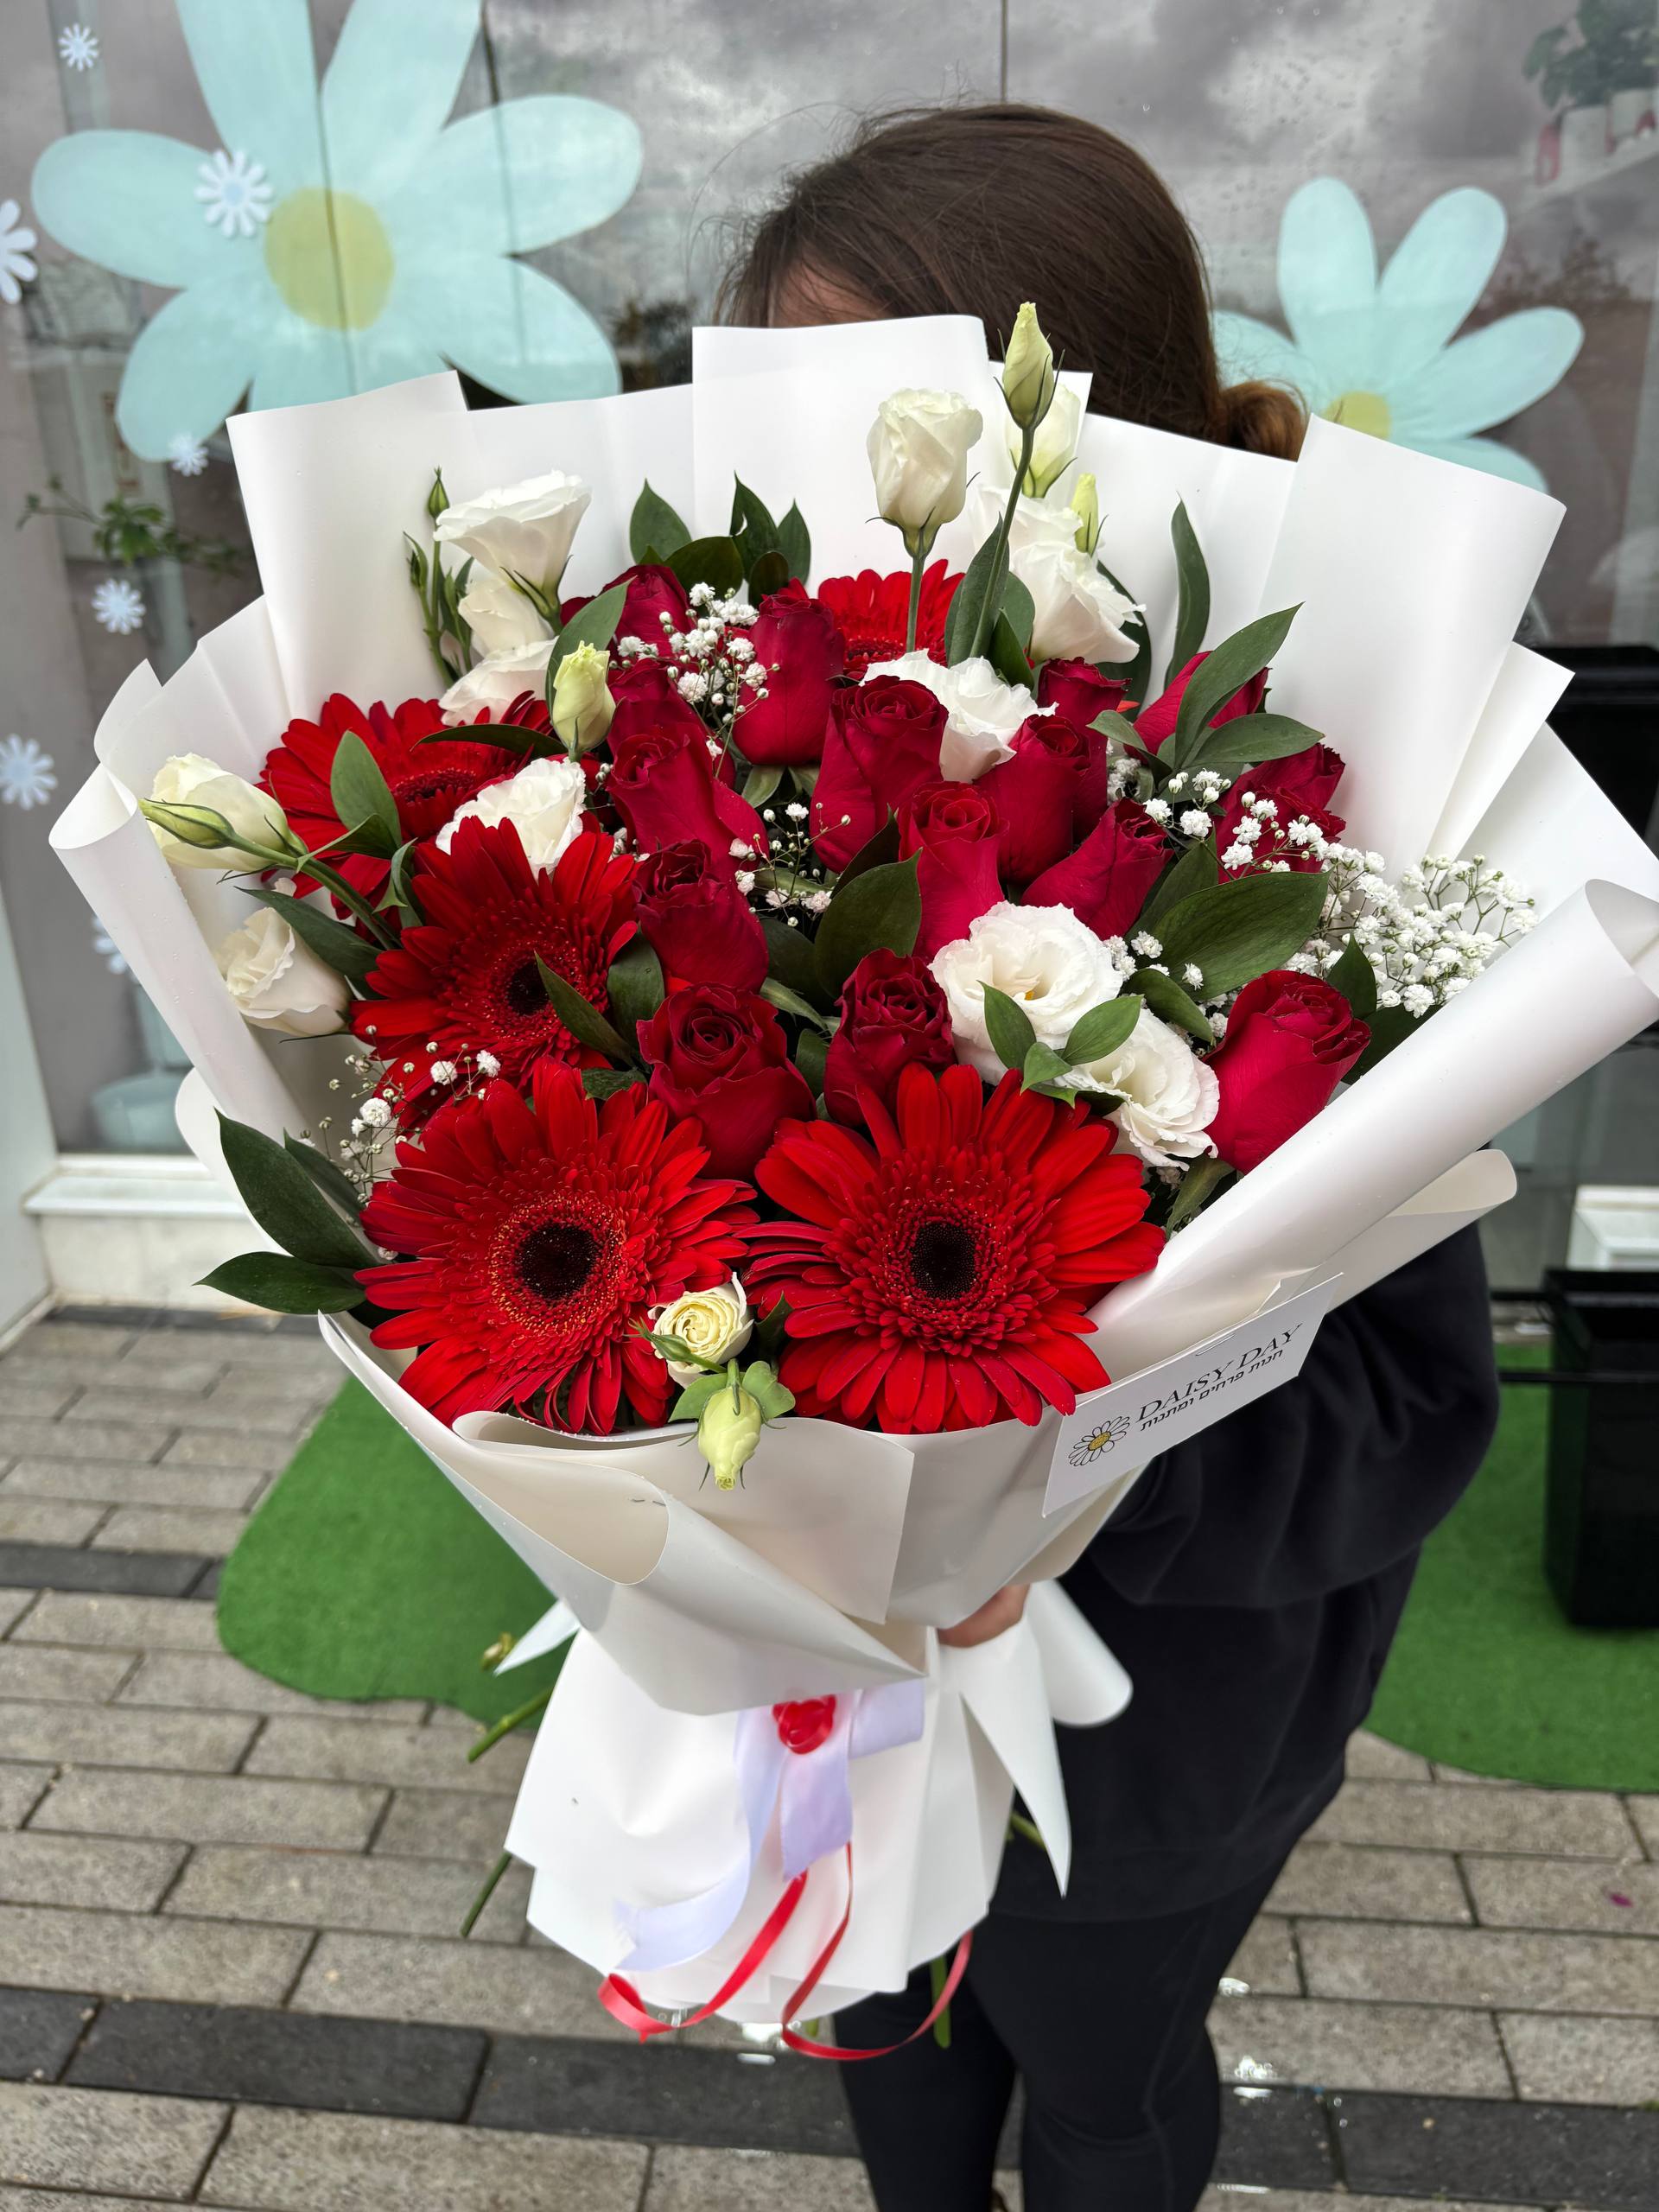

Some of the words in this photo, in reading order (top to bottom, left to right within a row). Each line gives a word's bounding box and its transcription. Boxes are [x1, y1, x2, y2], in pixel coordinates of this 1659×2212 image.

[1135, 1360, 1234, 1422] DAISY
[1236, 1323, 1302, 1369] DAY
[1249, 1350, 1283, 1373] חנות
[1199, 1370, 1244, 1399] פרחים
[1140, 1399, 1193, 1432] ומתנות
